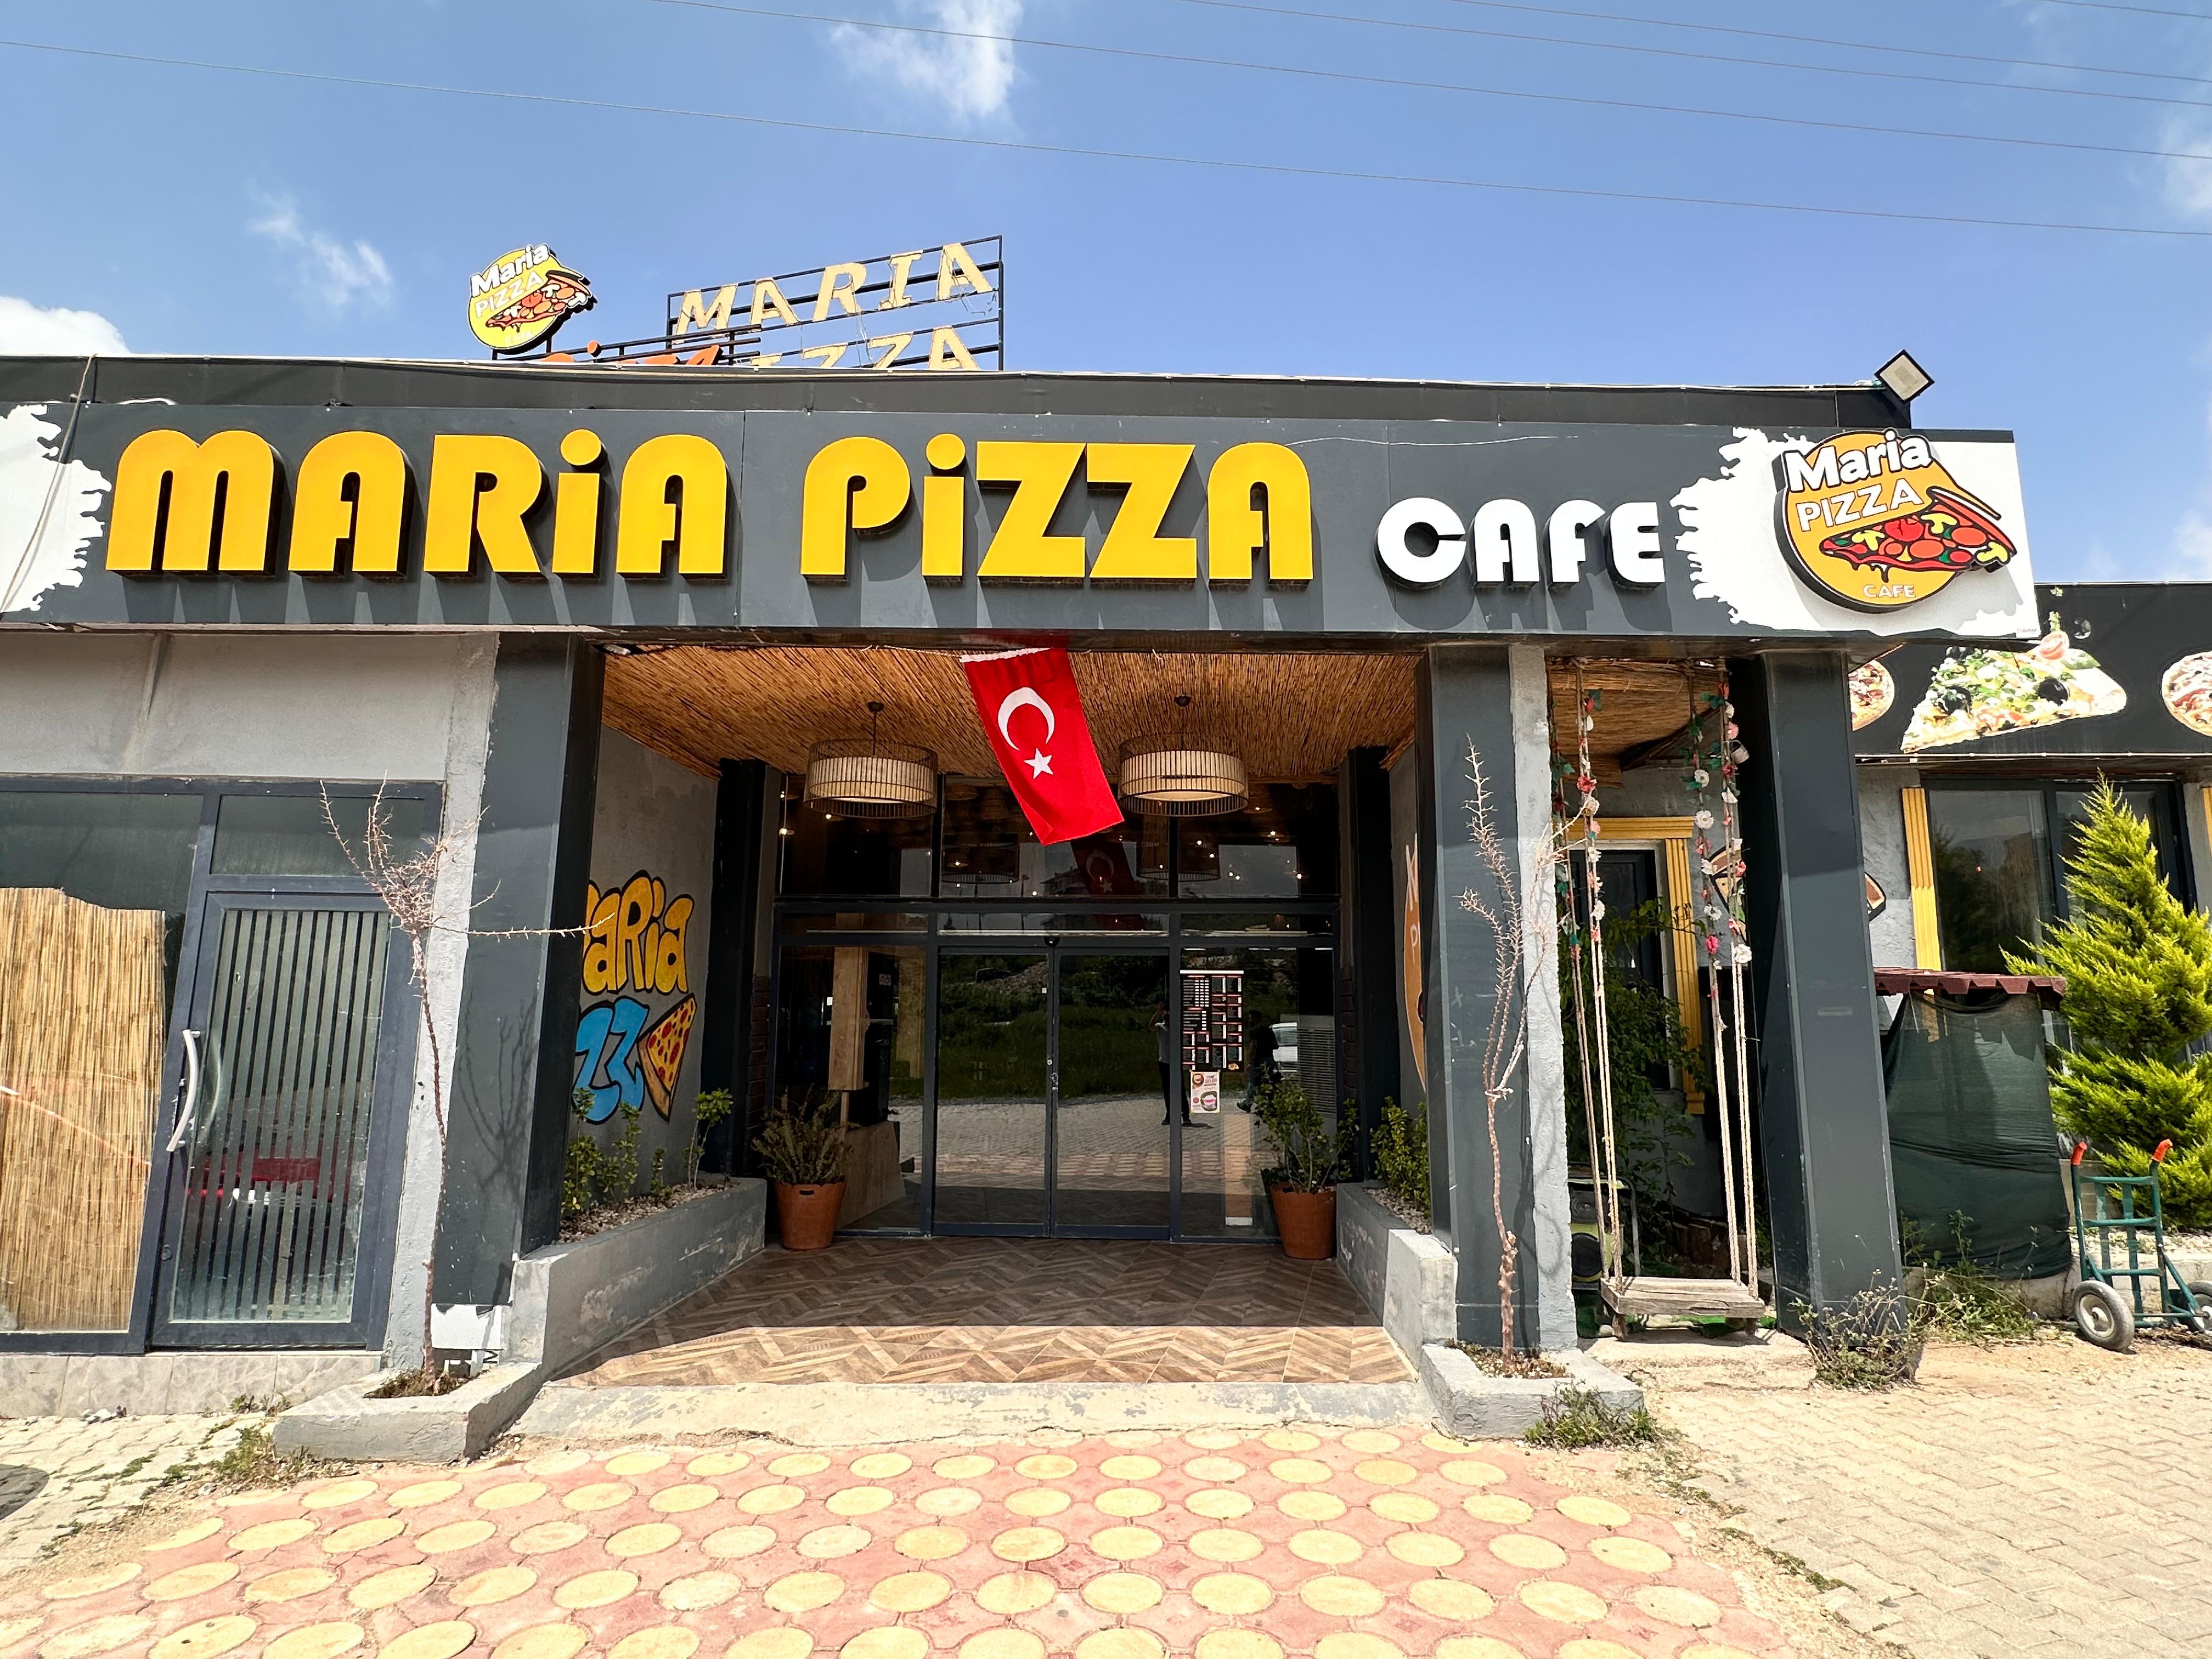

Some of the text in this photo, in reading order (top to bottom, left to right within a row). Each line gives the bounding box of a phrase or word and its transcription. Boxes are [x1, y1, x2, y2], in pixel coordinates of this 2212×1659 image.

[471, 245, 549, 297] Maria
[475, 271, 543, 318] PIZZA
[672, 242, 994, 345] MARIA
[1784, 428, 1932, 493] Maria
[1796, 477, 1923, 532] PIZZA
[1377, 496, 1666, 585] CAFE
[1863, 584, 1917, 599] CAFE
